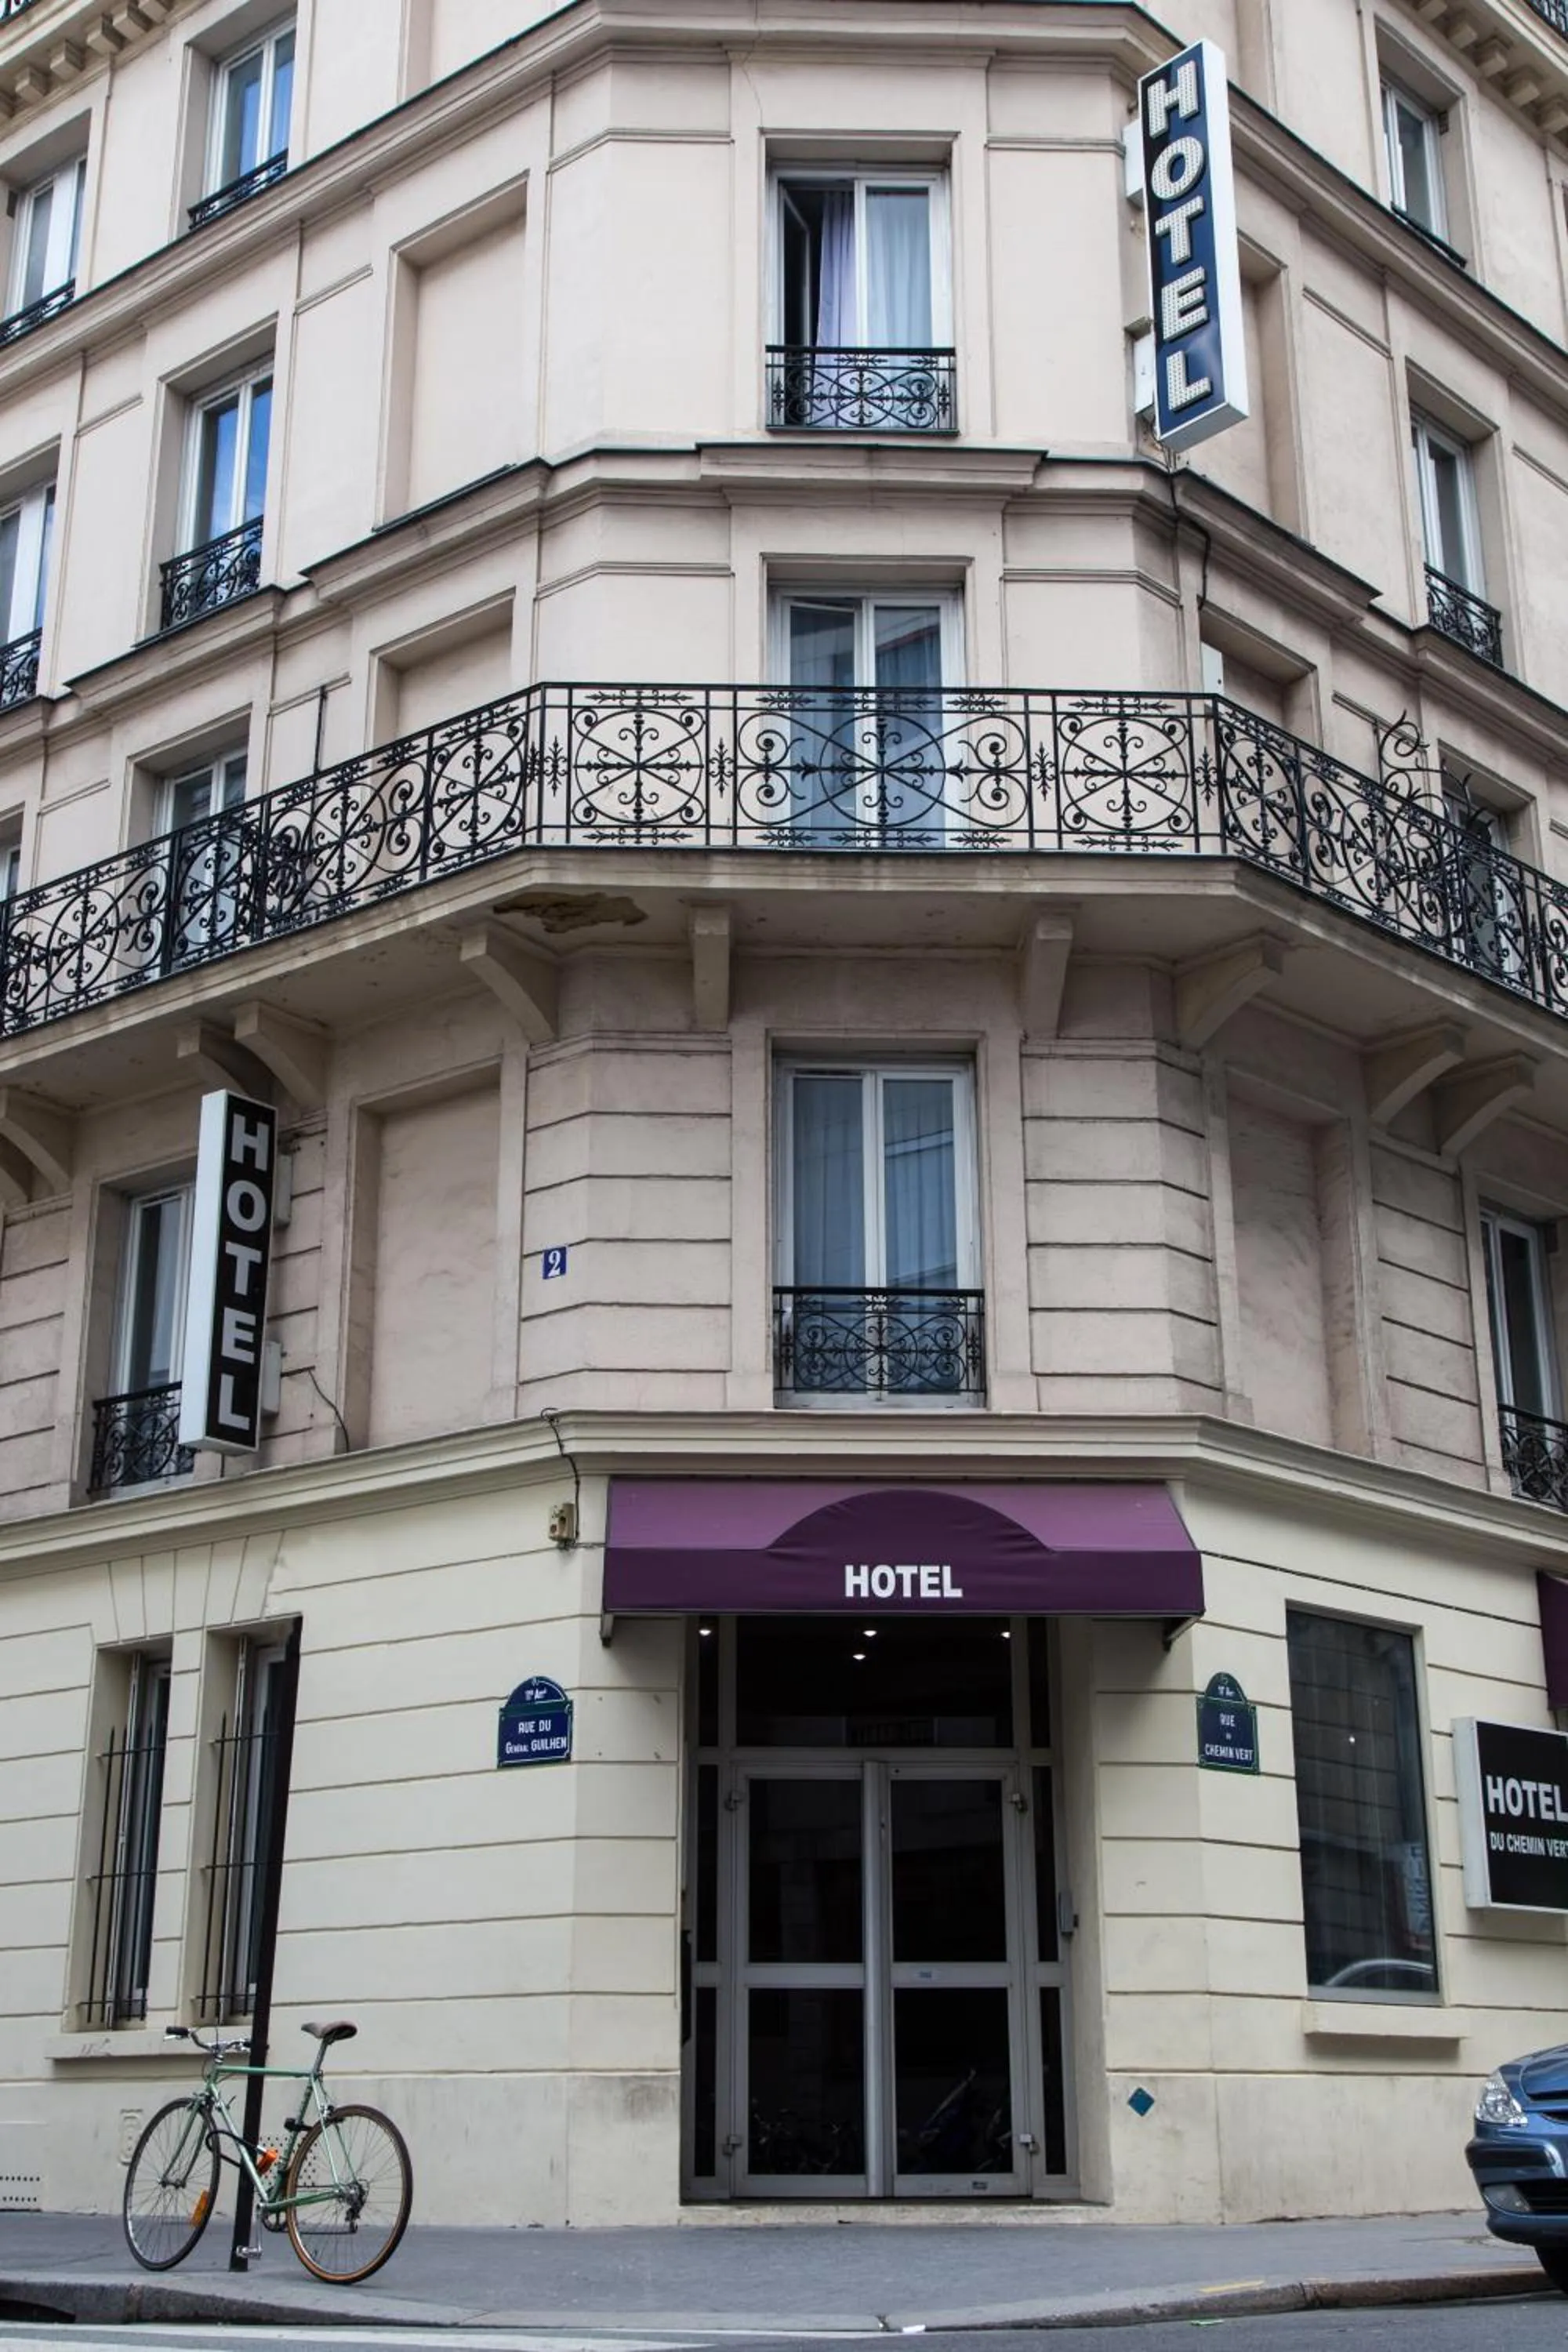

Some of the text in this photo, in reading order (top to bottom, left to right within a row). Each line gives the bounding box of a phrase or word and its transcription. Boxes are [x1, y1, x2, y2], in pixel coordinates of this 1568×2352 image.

[1147, 60, 1212, 412] HOTEL
[218, 1113, 269, 1431] HOTEL
[548, 1249, 561, 1277] 2
[844, 1564, 964, 1599] HOTEL
[517, 1719, 551, 1734] RUE DU
[1235, 1748, 1254, 1761] VERT
[1486, 1774, 1568, 1823] HOTEL
[1490, 1831, 1504, 1851] DU
[1506, 1833, 1545, 1856] CHEMIN
